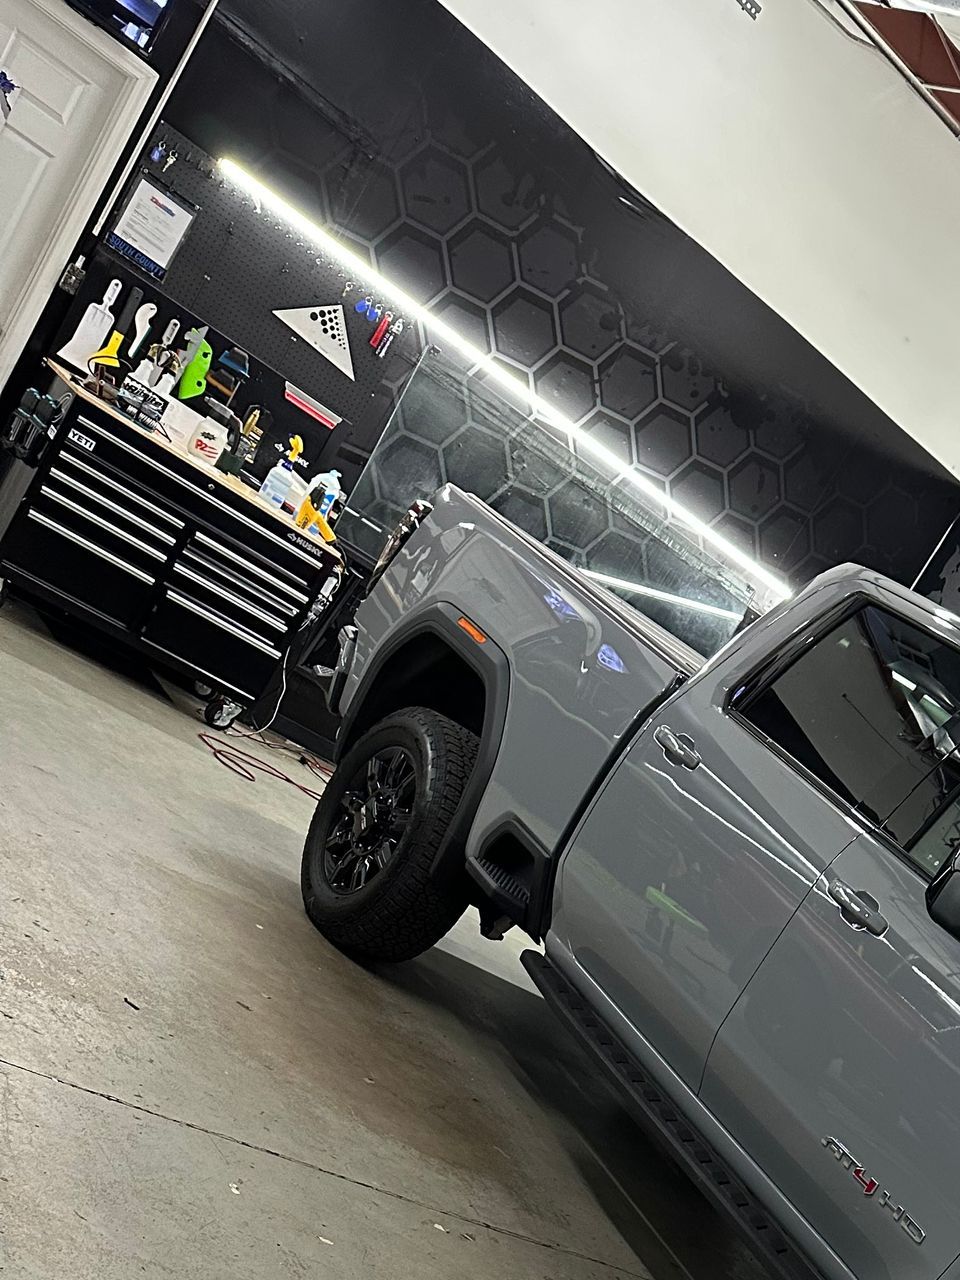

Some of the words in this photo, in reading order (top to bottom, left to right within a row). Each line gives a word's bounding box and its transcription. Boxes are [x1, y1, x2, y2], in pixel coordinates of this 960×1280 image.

[109, 234, 135, 256] SOUTH
[134, 252, 164, 276] COUNTY
[71, 432, 94, 448] YETI
[296, 536, 323, 557] HUSKY
